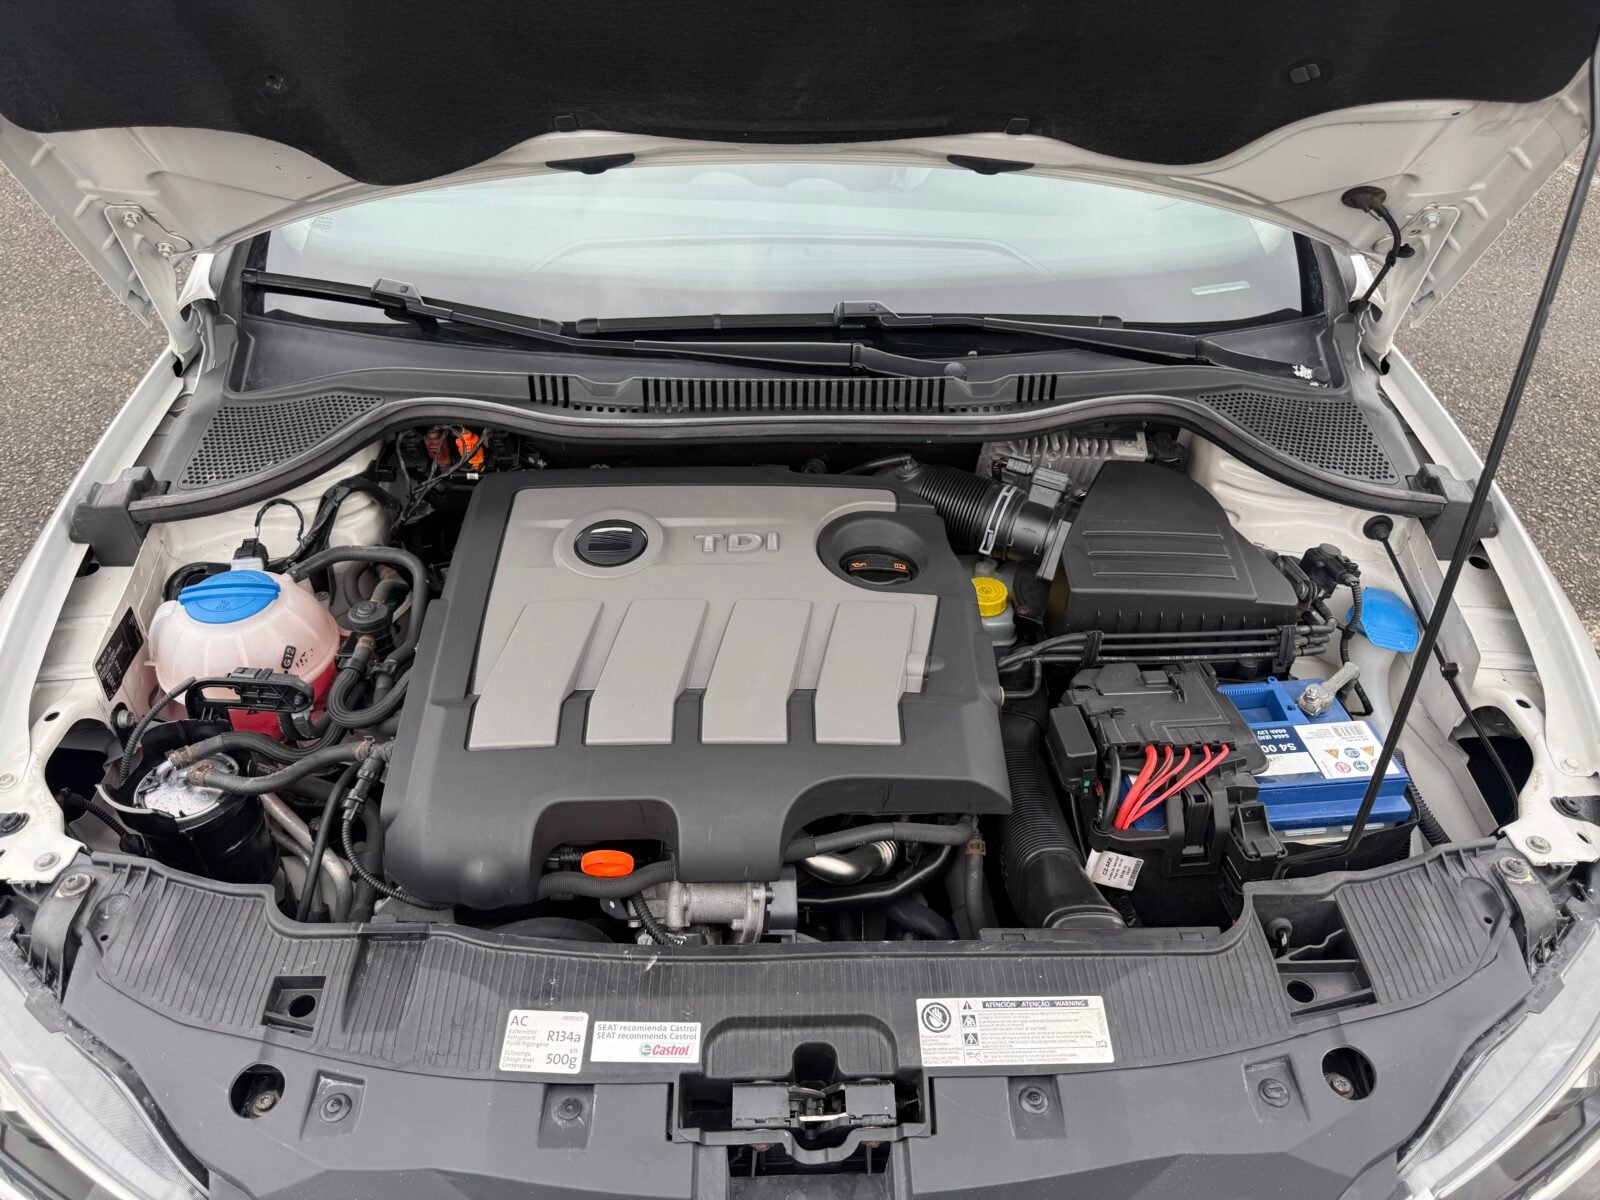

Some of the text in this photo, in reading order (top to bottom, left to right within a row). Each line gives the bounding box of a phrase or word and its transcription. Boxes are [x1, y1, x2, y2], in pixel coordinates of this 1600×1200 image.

[694, 531, 781, 554] TDI
[284, 647, 295, 667] G12
[1279, 743, 1296, 751] S4
[985, 1000, 1016, 1008] ATENCIÓN
[1021, 1000, 1050, 1009] ATENÇÃO
[510, 1015, 529, 1027] AC
[597, 1024, 698, 1033] SEAT recomienda Castrol
[547, 1030, 581, 1043] R134a
[596, 1032, 697, 1041] SEAT recommends Castrol
[652, 1044, 690, 1056] Castrol
[545, 1053, 578, 1070] 500g
